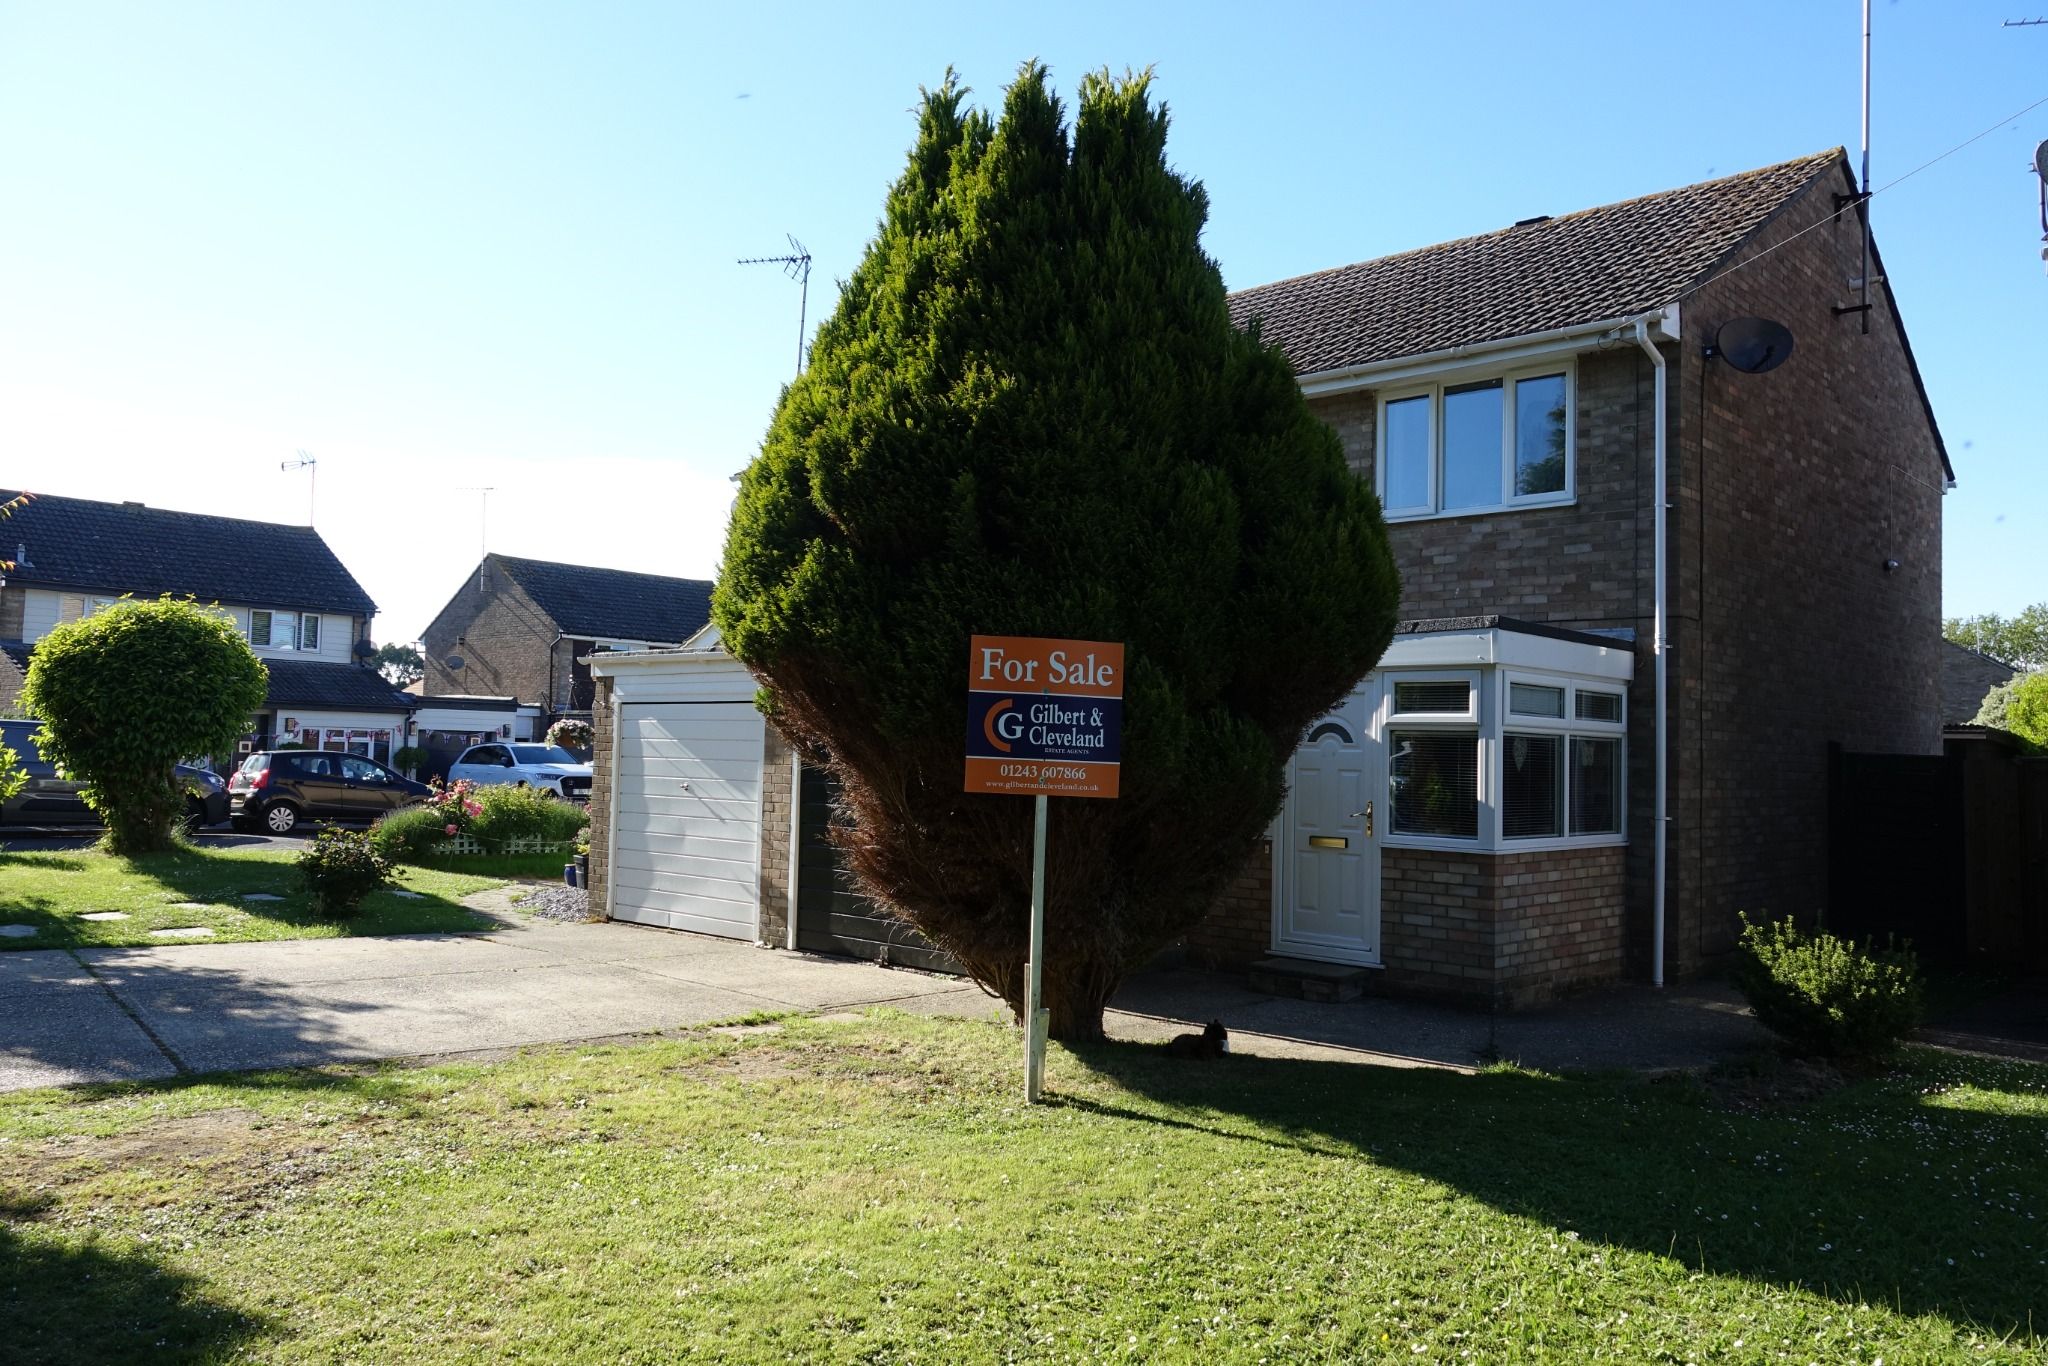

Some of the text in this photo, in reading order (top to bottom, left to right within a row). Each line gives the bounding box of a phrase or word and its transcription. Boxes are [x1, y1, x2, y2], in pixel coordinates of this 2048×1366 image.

[979, 648, 1113, 686] For Sale
[1030, 703, 1103, 727] Gilbert &
[1029, 725, 1105, 748] Cleveland
[1044, 747, 1066, 755] ESTATE
[1000, 764, 1086, 780] 01243 607866
[985, 780, 1099, 792] www.gilbertandcleveland.co.uk
